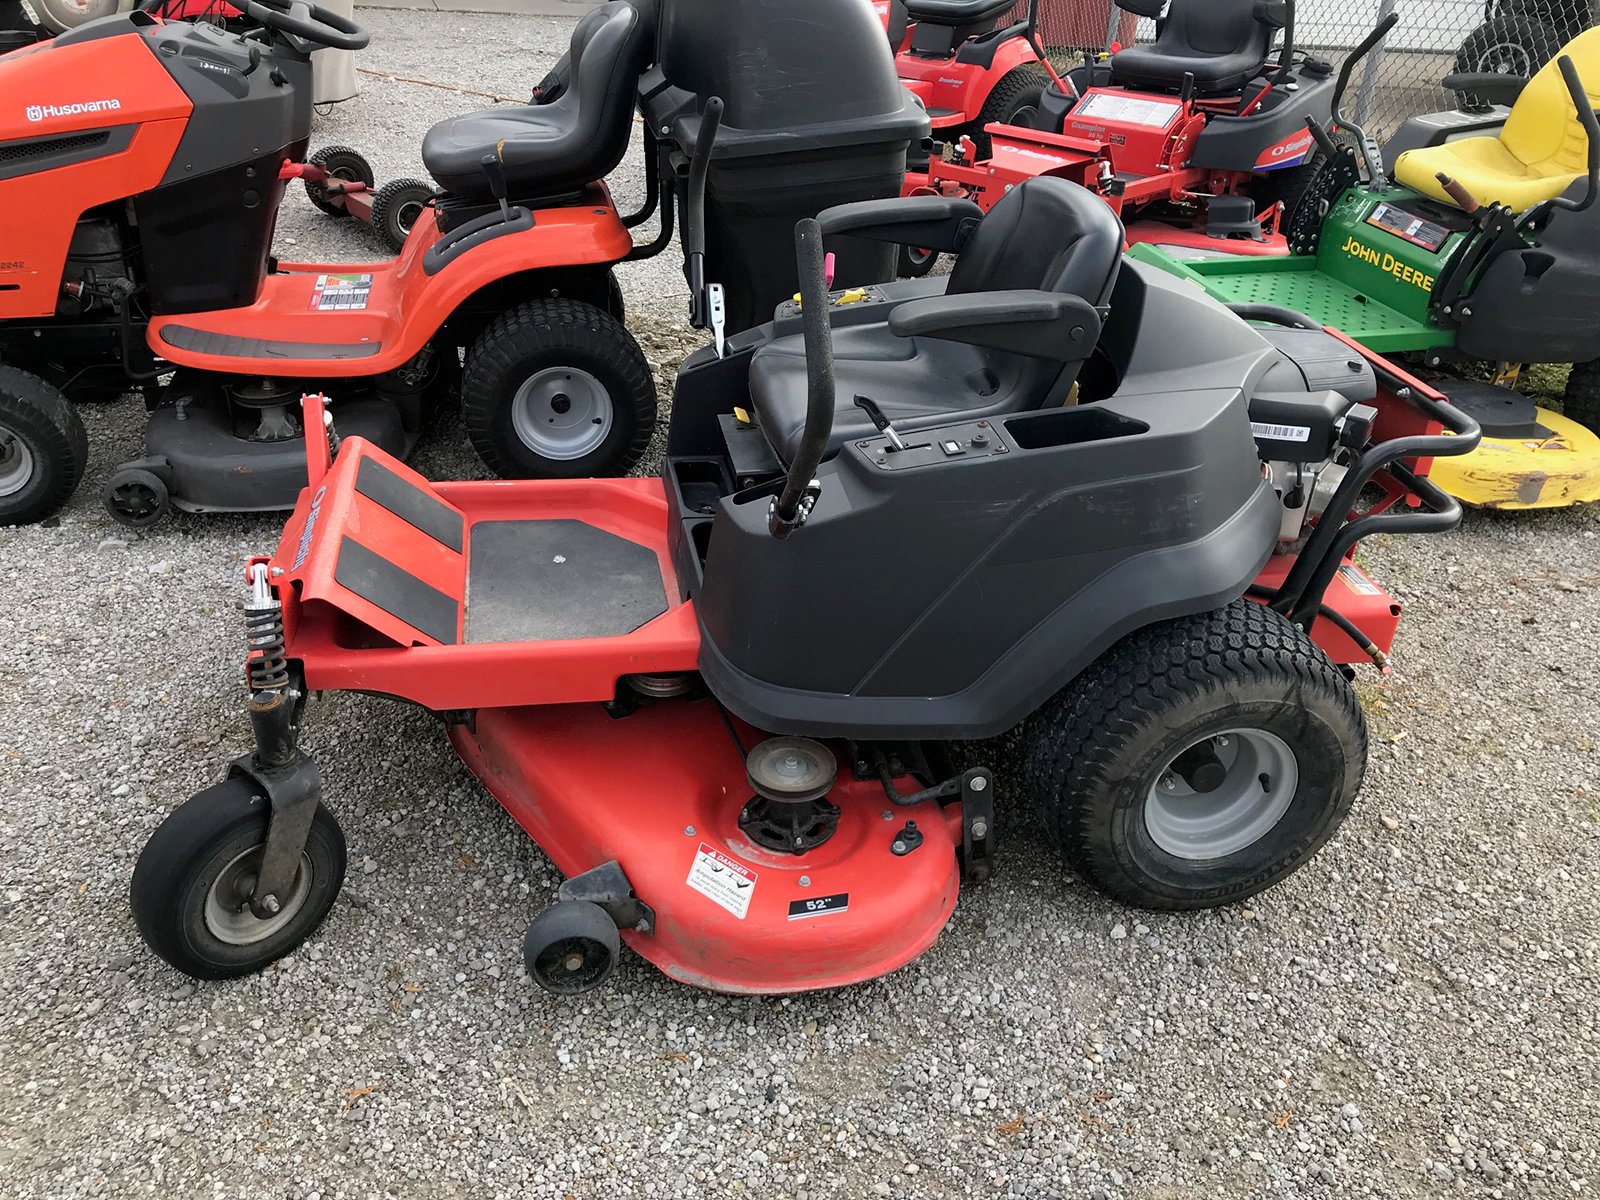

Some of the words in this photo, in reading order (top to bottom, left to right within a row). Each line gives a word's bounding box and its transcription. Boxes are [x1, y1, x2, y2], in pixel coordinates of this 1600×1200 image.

[42, 98, 122, 118] Husqvarna
[1071, 121, 1106, 133] Champion
[1341, 235, 1381, 267] JOHN
[1381, 252, 1435, 293] DEERE
[290, 505, 321, 573] Simplicity
[716, 855, 749, 877] DANGER
[806, 898, 832, 910] 52"
